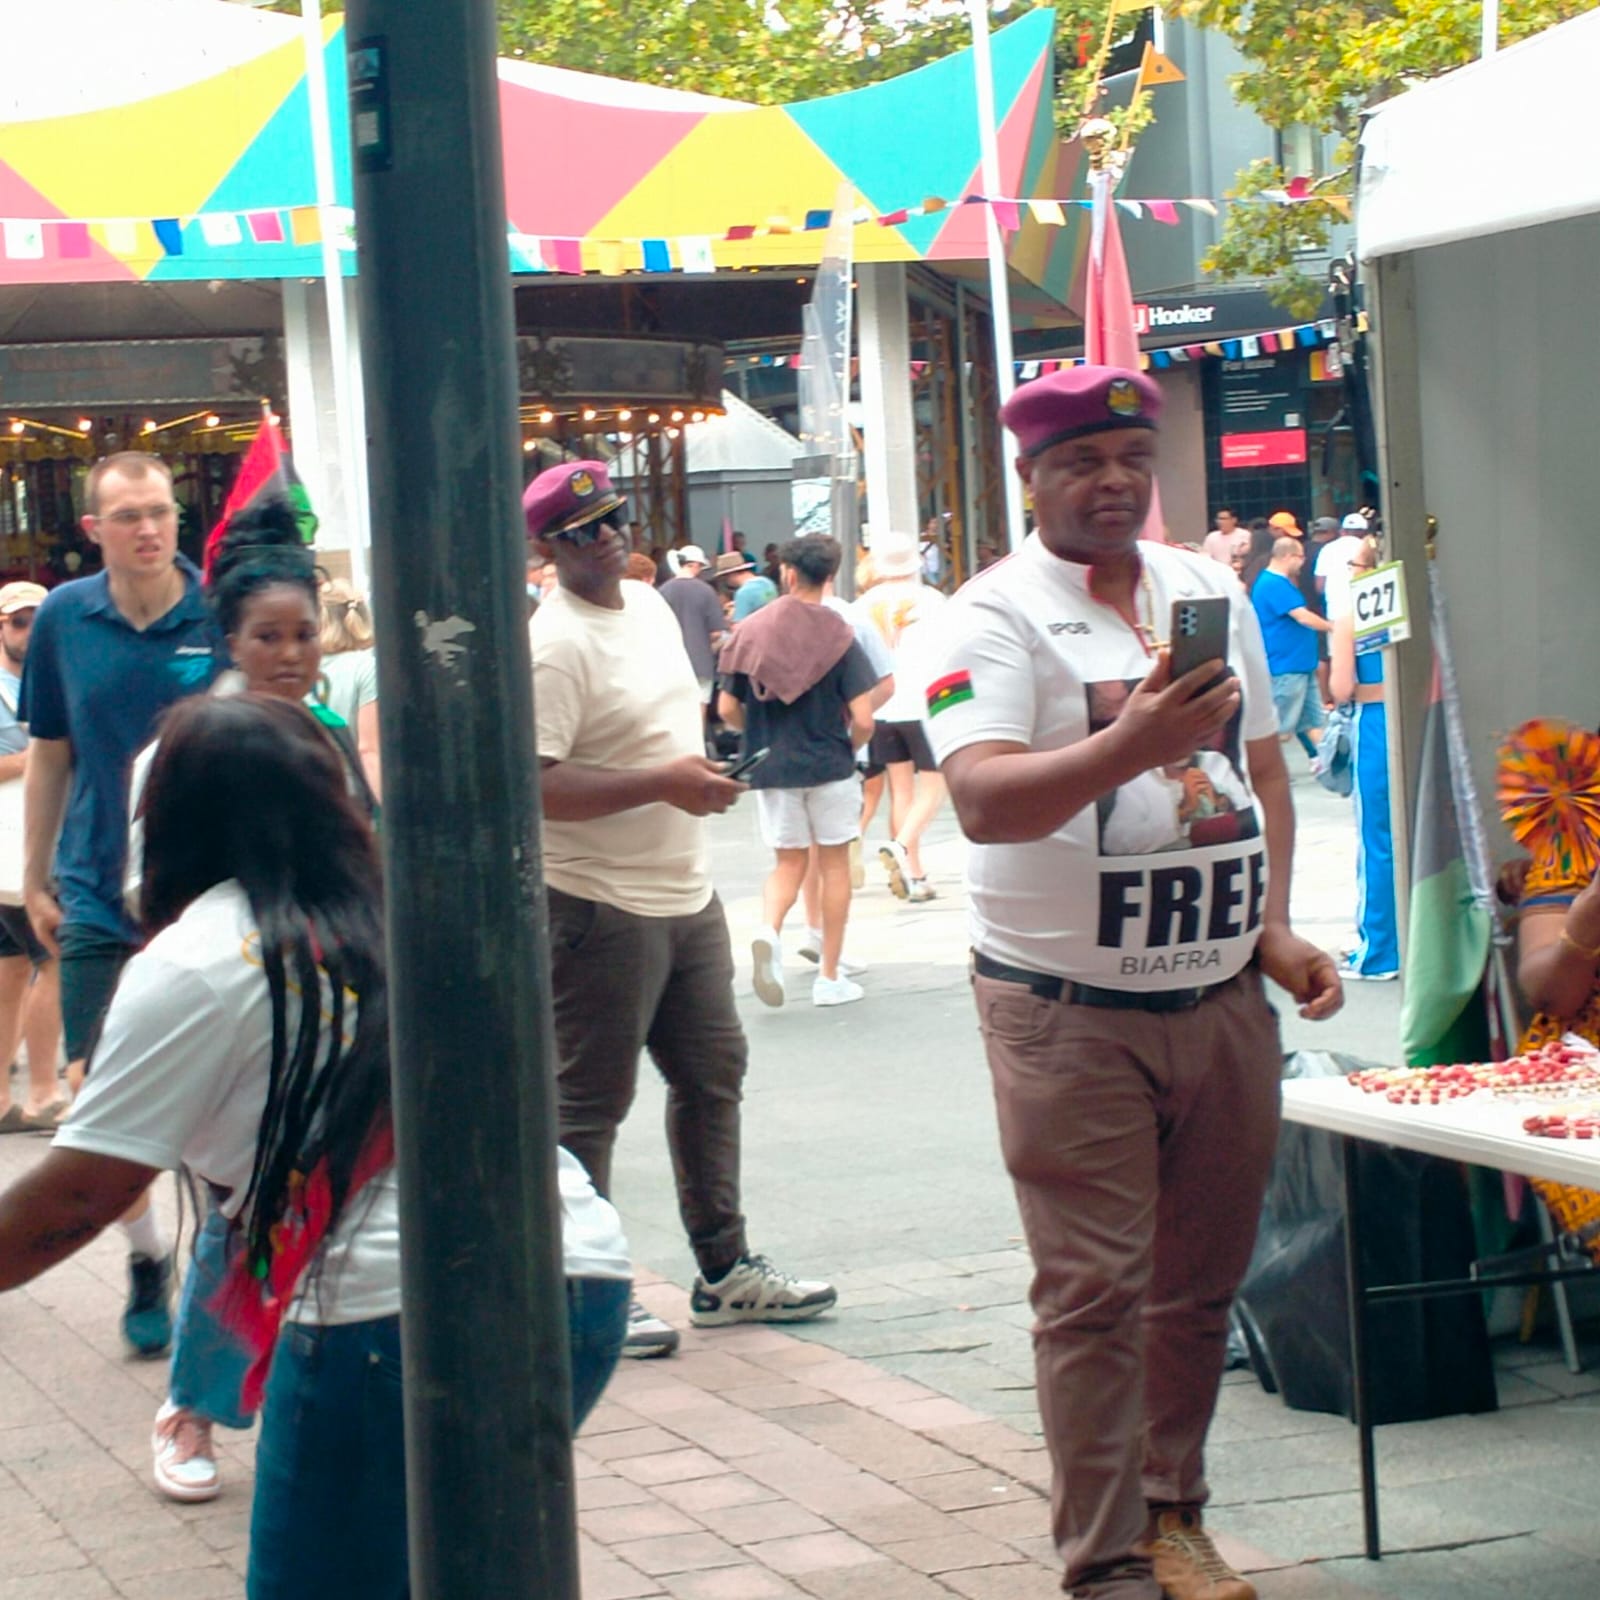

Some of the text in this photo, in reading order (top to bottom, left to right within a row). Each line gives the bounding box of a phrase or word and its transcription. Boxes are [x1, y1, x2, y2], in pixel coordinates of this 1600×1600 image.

[1149, 304, 1215, 326] Hooker
[1356, 581, 1394, 621] C27
[1098, 851, 1264, 948] FREE
[1120, 949, 1221, 975] BIAFRA
